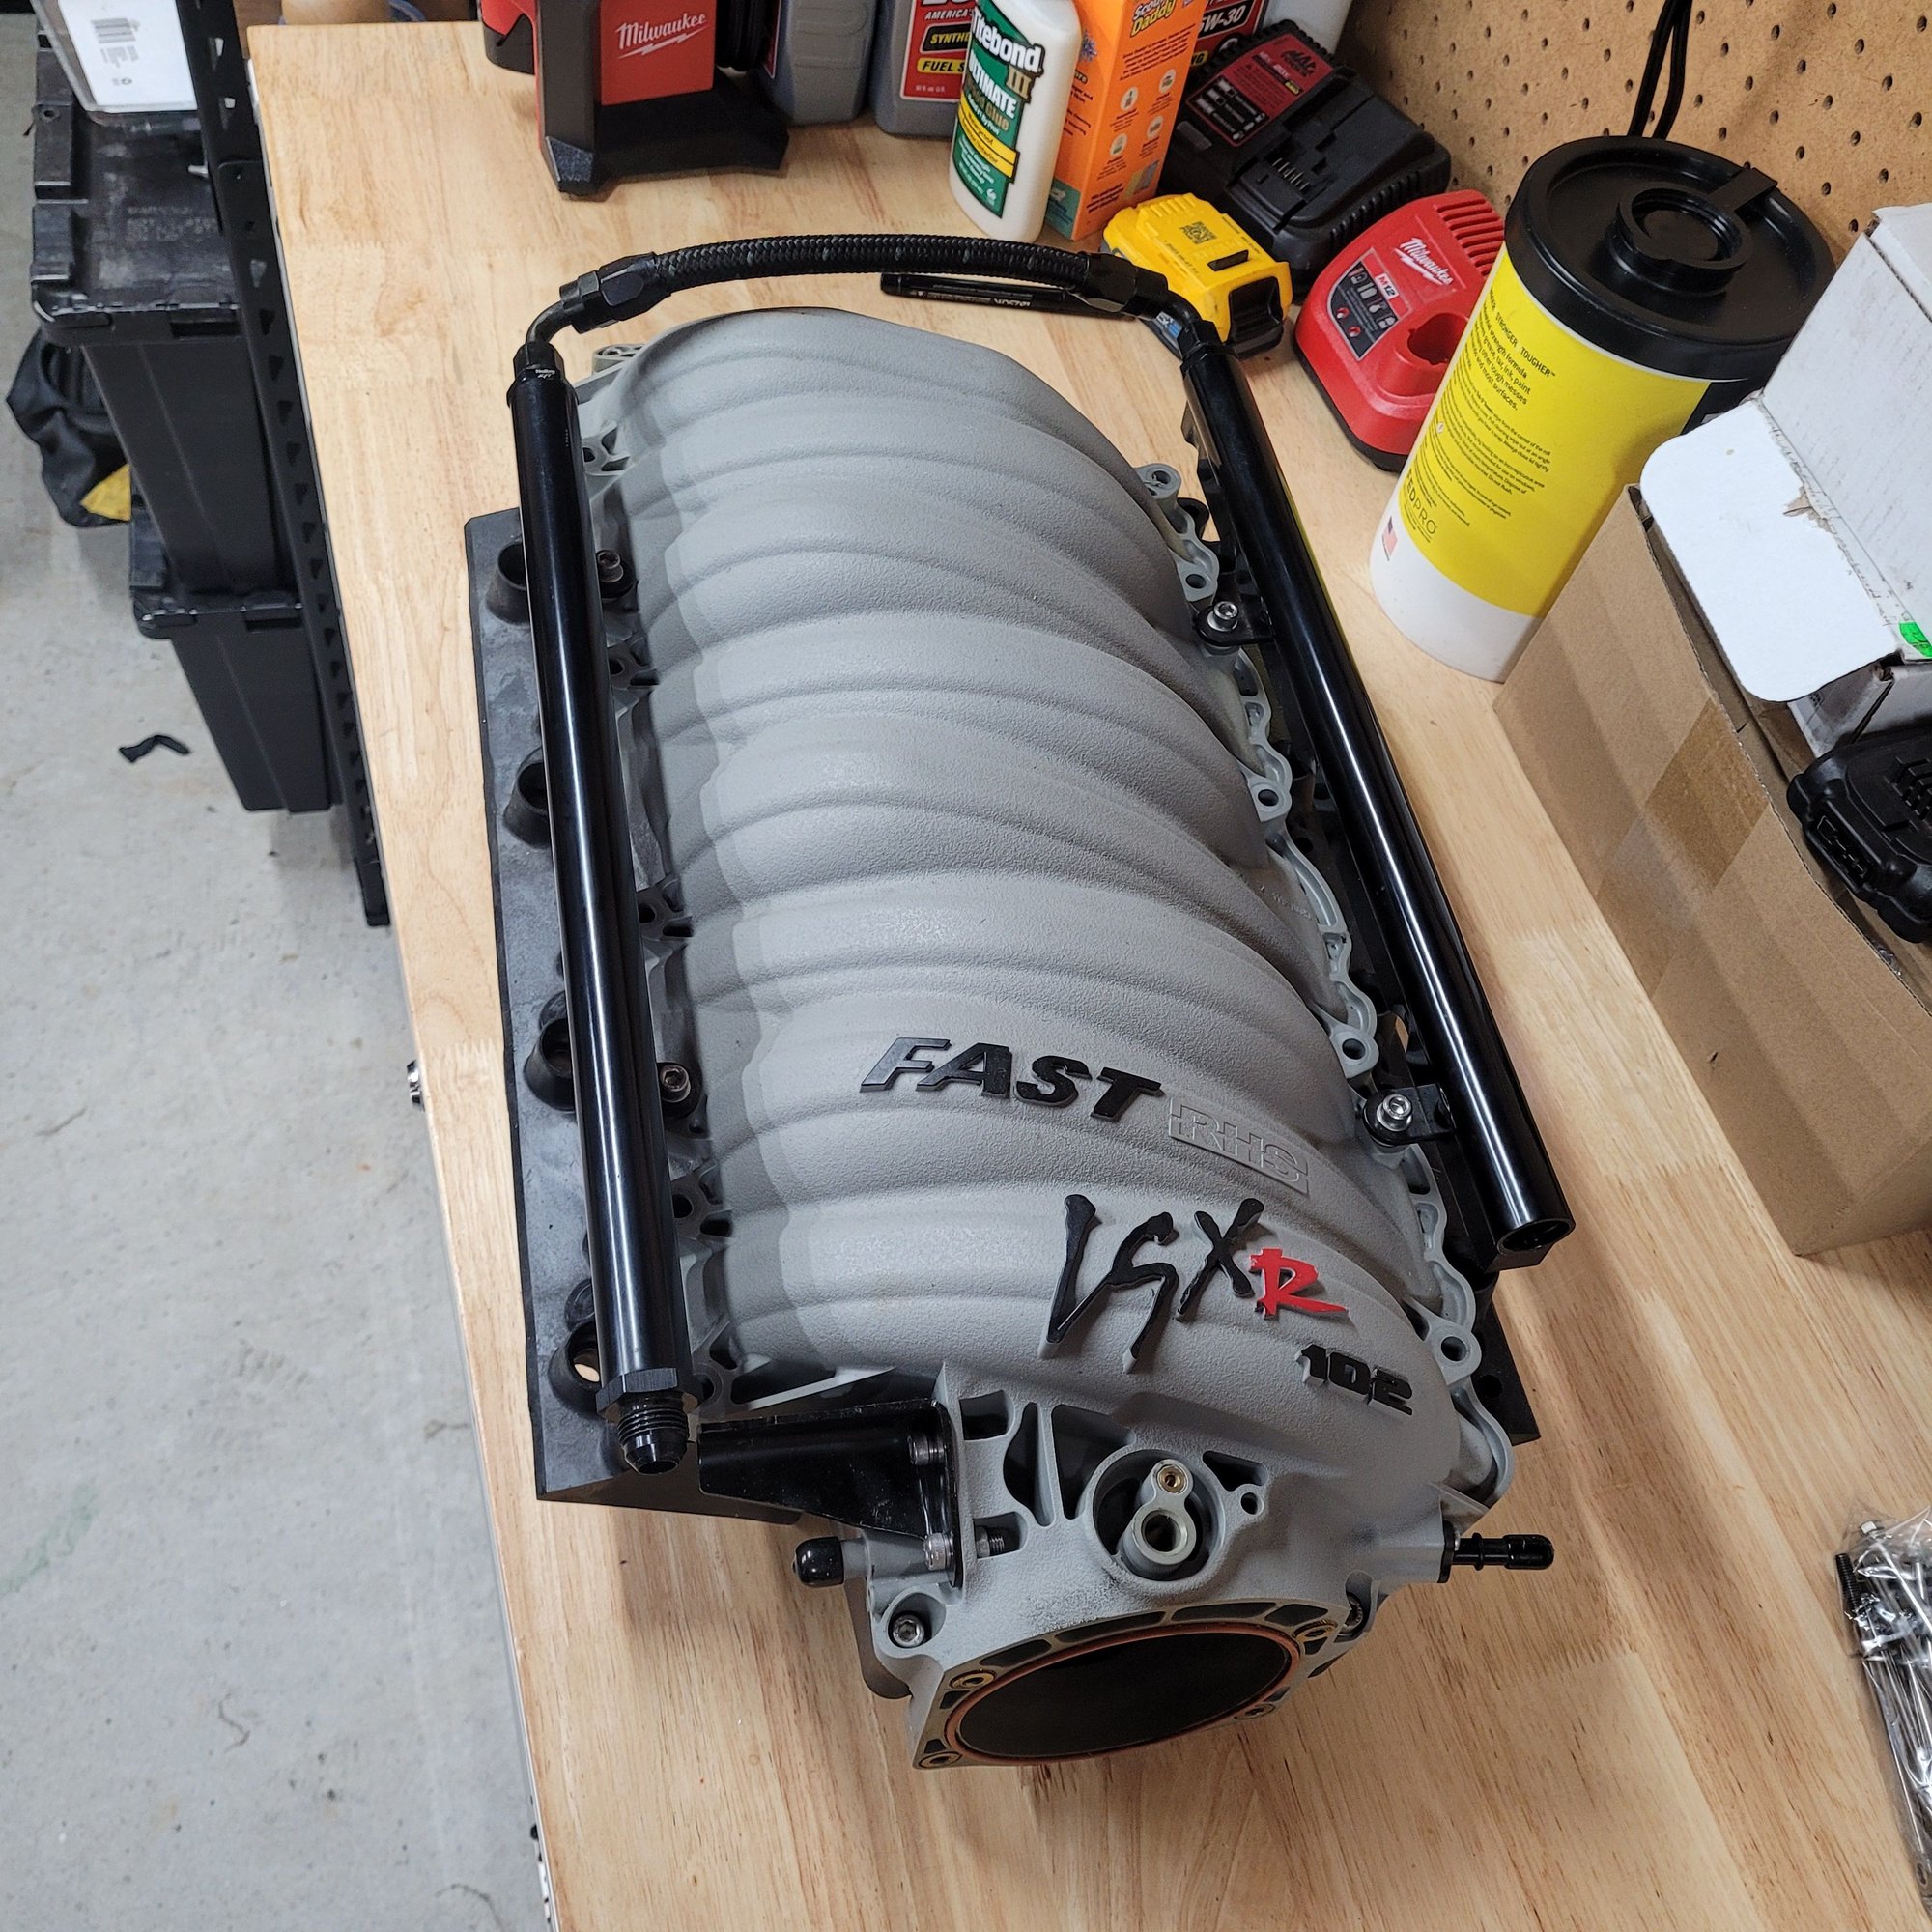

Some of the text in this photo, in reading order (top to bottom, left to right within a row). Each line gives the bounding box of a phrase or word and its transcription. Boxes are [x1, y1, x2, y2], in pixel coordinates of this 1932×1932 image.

[615, 13, 706, 49] Milwaukee
[972, 6, 1042, 73] Titebond
[1131, 0, 1176, 37] Daddy
[922, 61, 953, 71] FUEL
[969, 49, 1017, 119] ULTIMATE
[1399, 237, 1454, 285] Milwaukee
[1506, 353, 1528, 379] formula
[1513, 377, 1531, 395] paint
[859, 1037, 1165, 1122] FAST
[1169, 1099, 1310, 1194] RHS
[1299, 1343, 1412, 1416] 102
